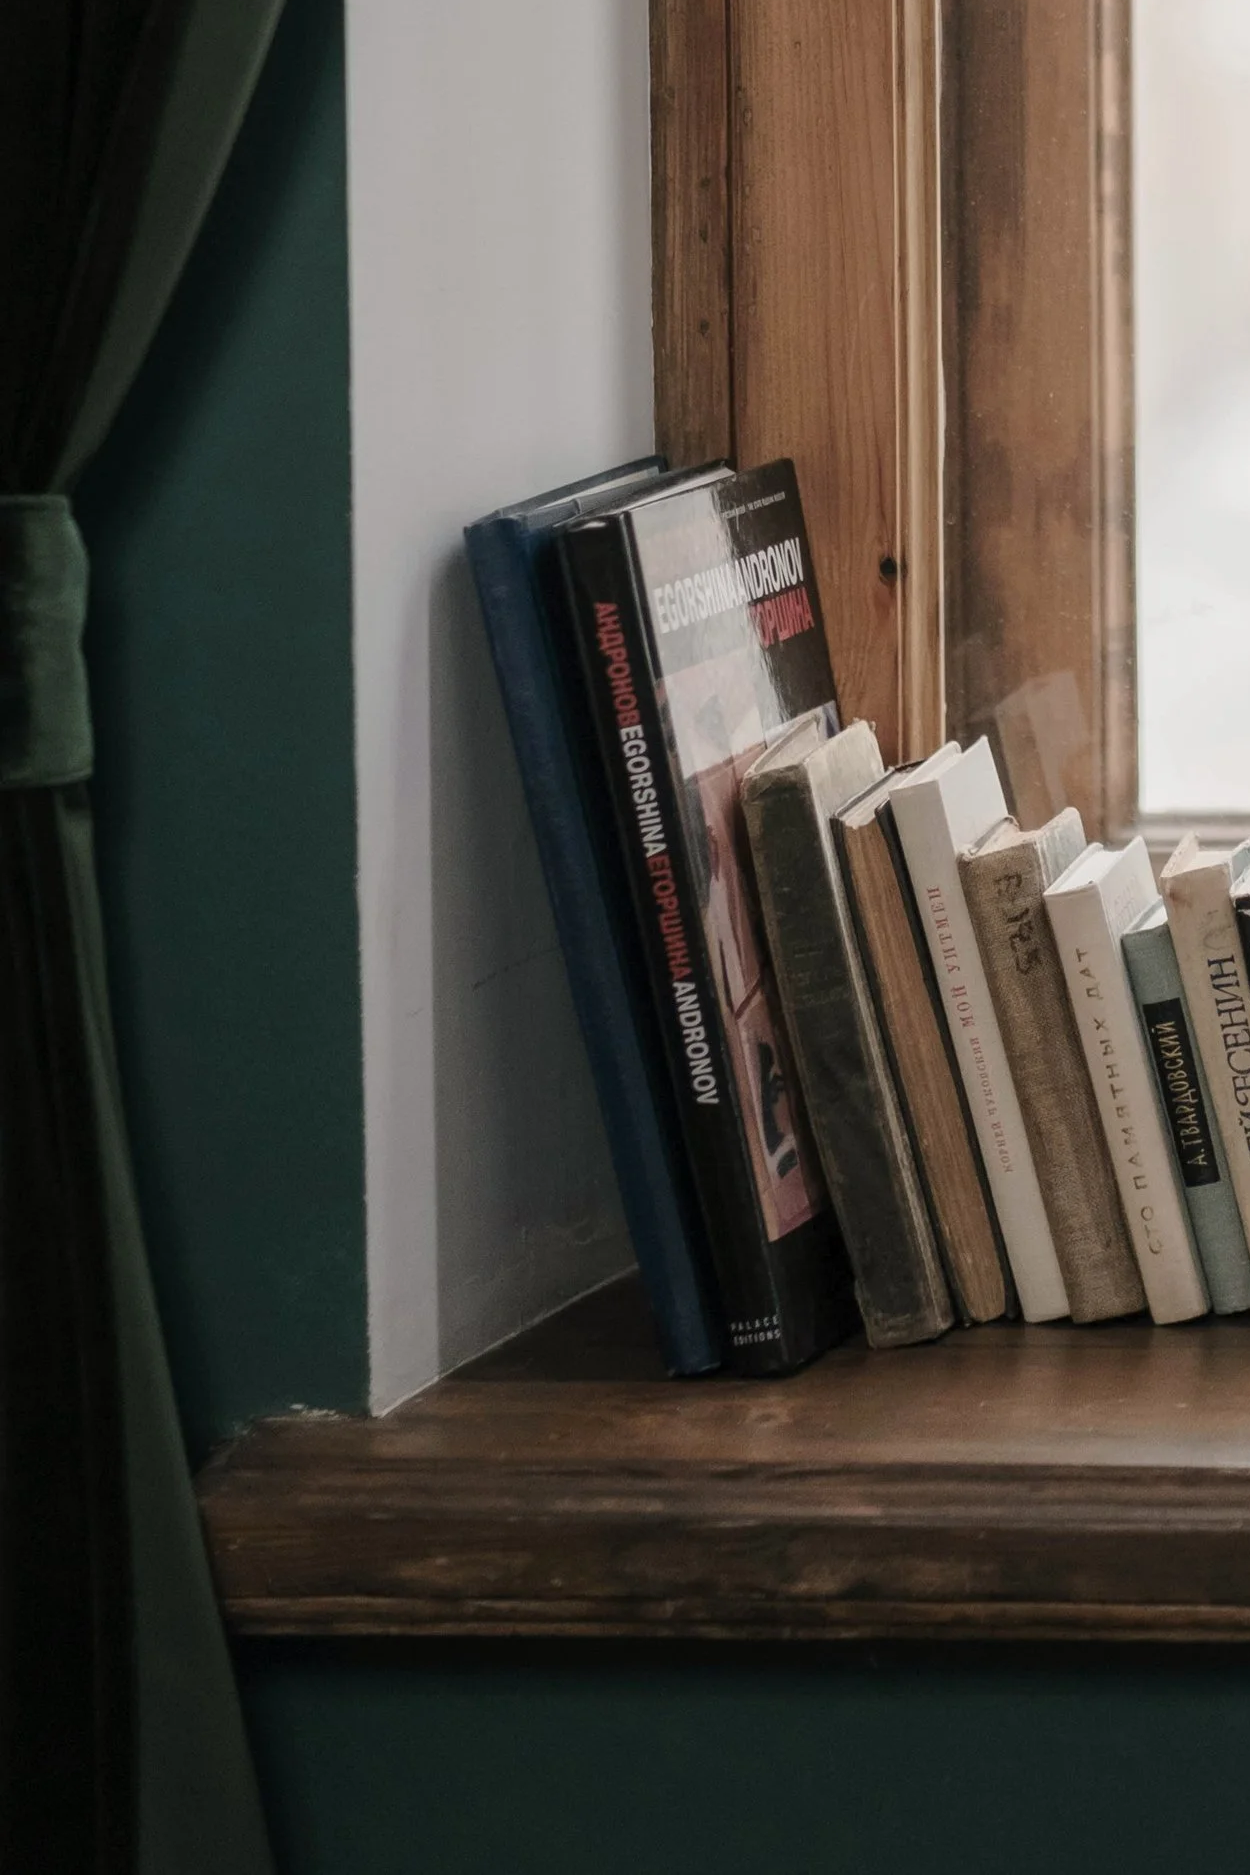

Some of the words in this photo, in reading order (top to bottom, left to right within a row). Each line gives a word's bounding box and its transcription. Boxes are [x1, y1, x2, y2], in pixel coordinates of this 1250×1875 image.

[926, 885, 960, 974] УИТМЕН
[1076, 948, 1103, 1000] ДАТ
[1093, 1017, 1148, 1190] ПАМЯТНЫХ
[1141, 1205, 1163, 1255] СТО
